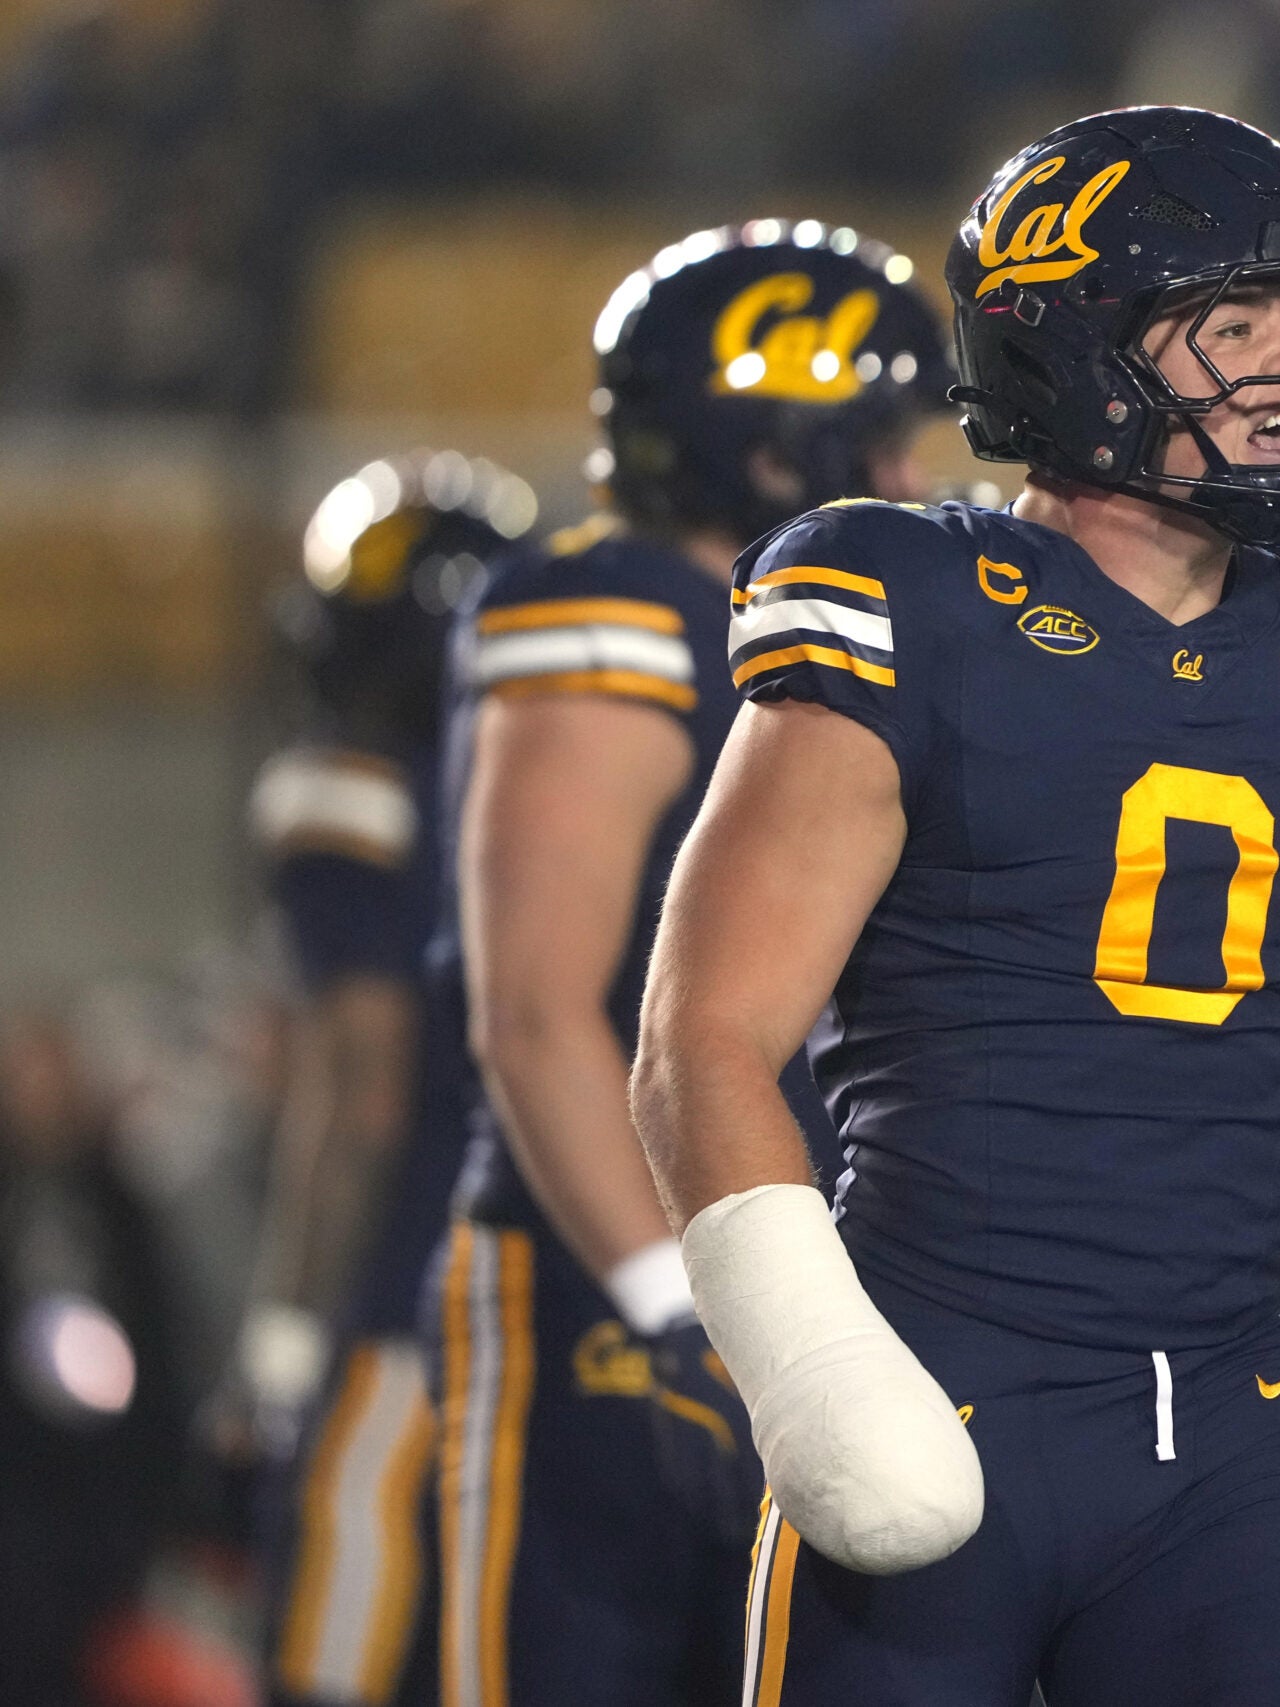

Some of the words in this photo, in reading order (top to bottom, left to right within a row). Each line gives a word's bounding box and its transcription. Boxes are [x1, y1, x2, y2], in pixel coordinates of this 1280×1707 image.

[975, 156, 1131, 299] Cal
[712, 271, 879, 404] Cal
[977, 554, 1028, 604] C
[1030, 615, 1087, 639] ACC
[1172, 648, 1204, 681] Cal
[1092, 762, 1280, 1026] 0
